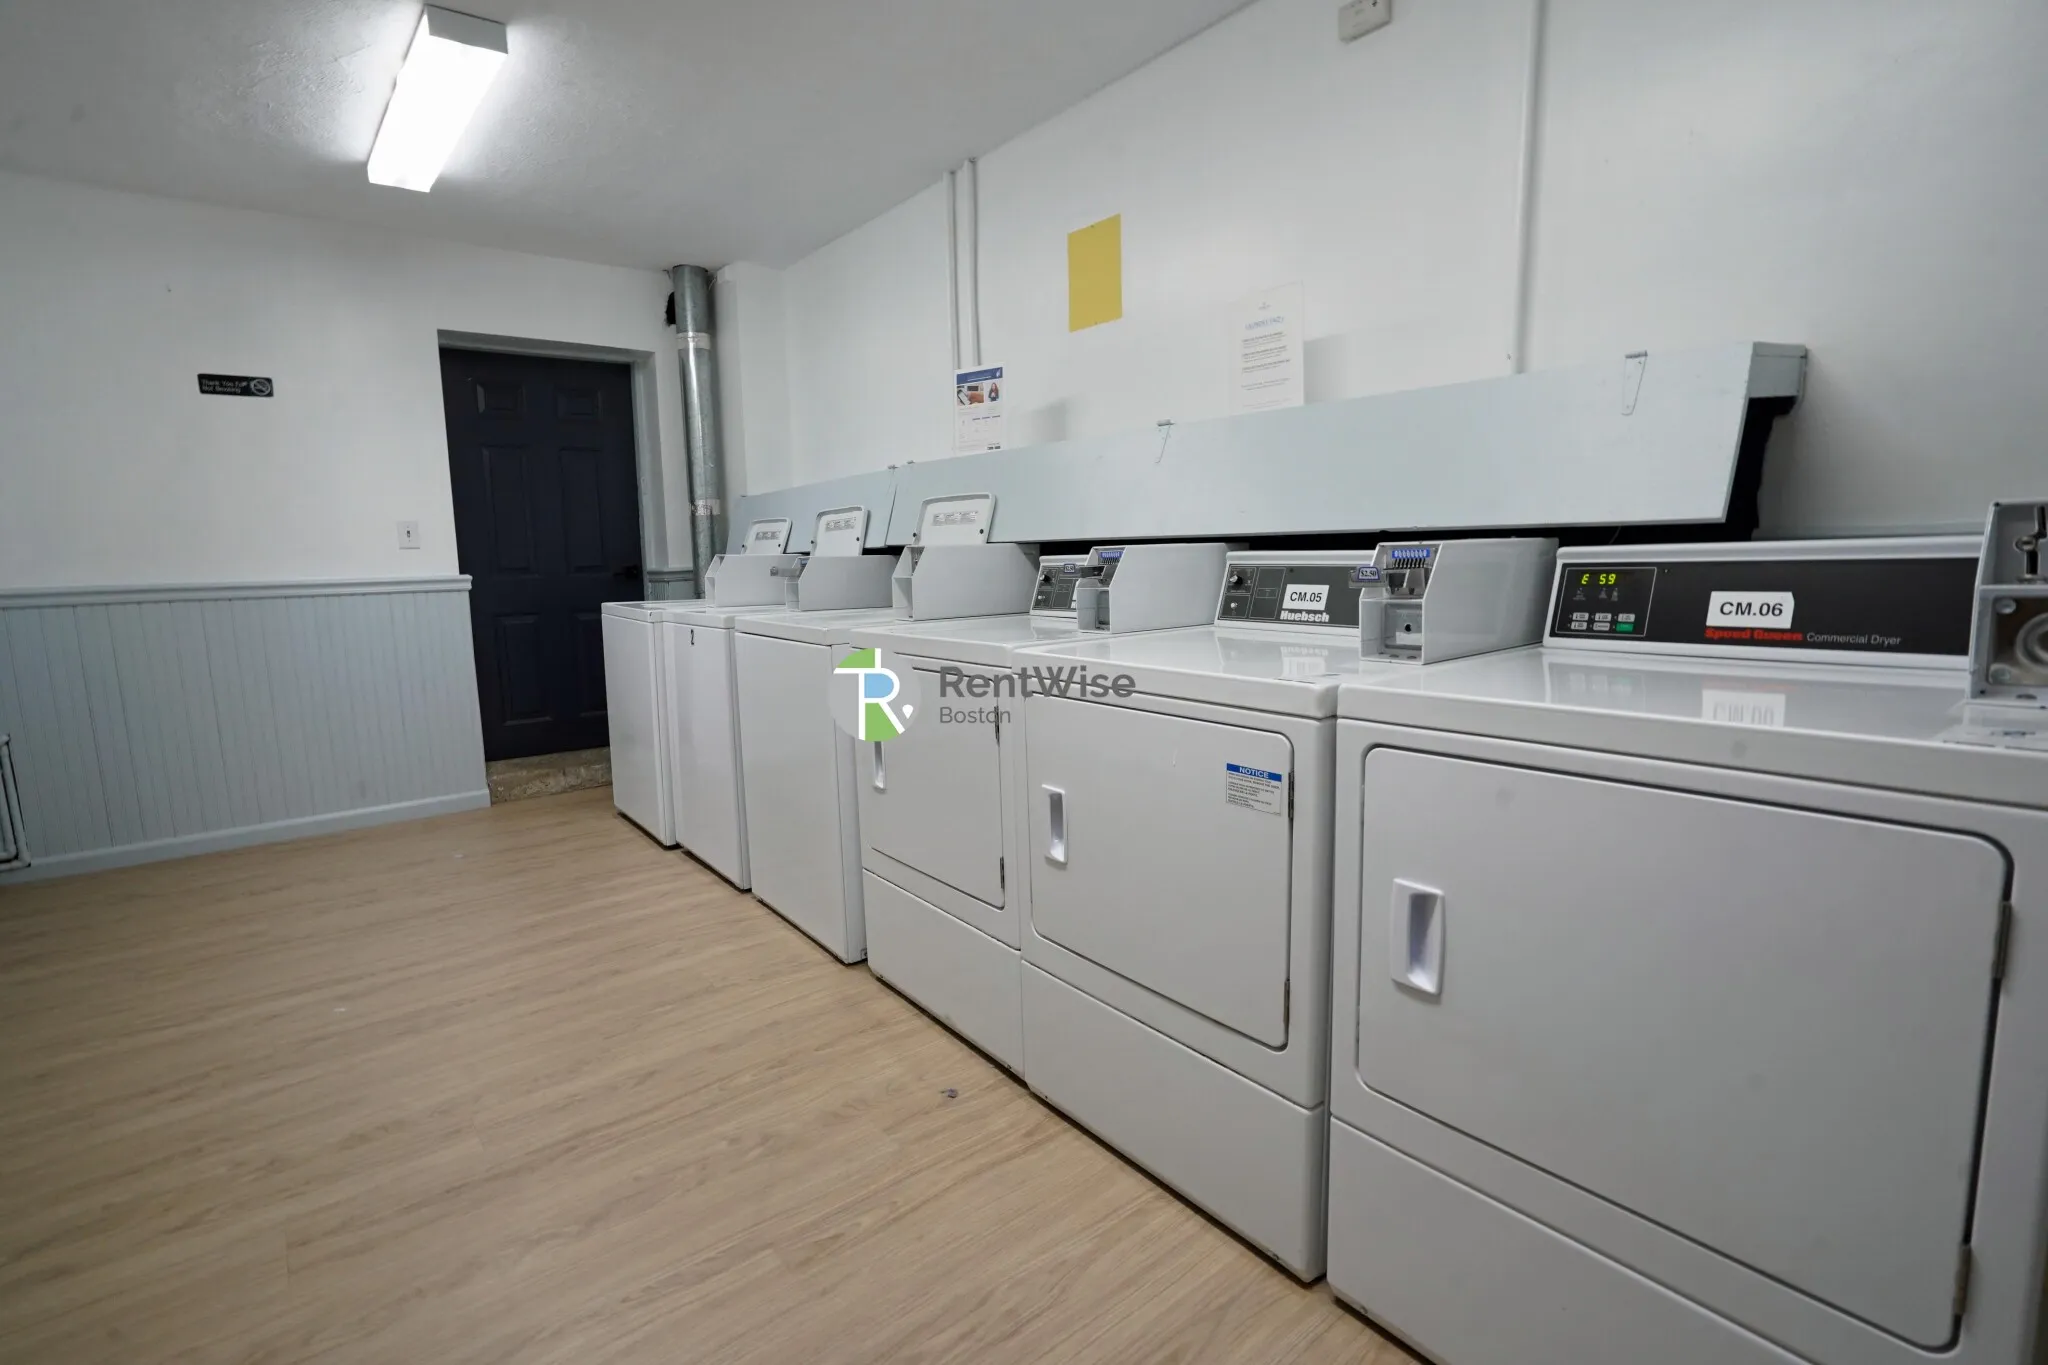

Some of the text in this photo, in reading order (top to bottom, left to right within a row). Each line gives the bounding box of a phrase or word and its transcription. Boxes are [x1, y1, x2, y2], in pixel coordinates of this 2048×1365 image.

[1290, 591, 1323, 603] CM.05
[1719, 601, 1784, 617] CM.06
[1280, 610, 1330, 622] Huebsch
[1806, 632, 1868, 644] Commercial
[1871, 635, 1902, 646] Dryer
[1239, 767, 1269, 778] NOTICE
